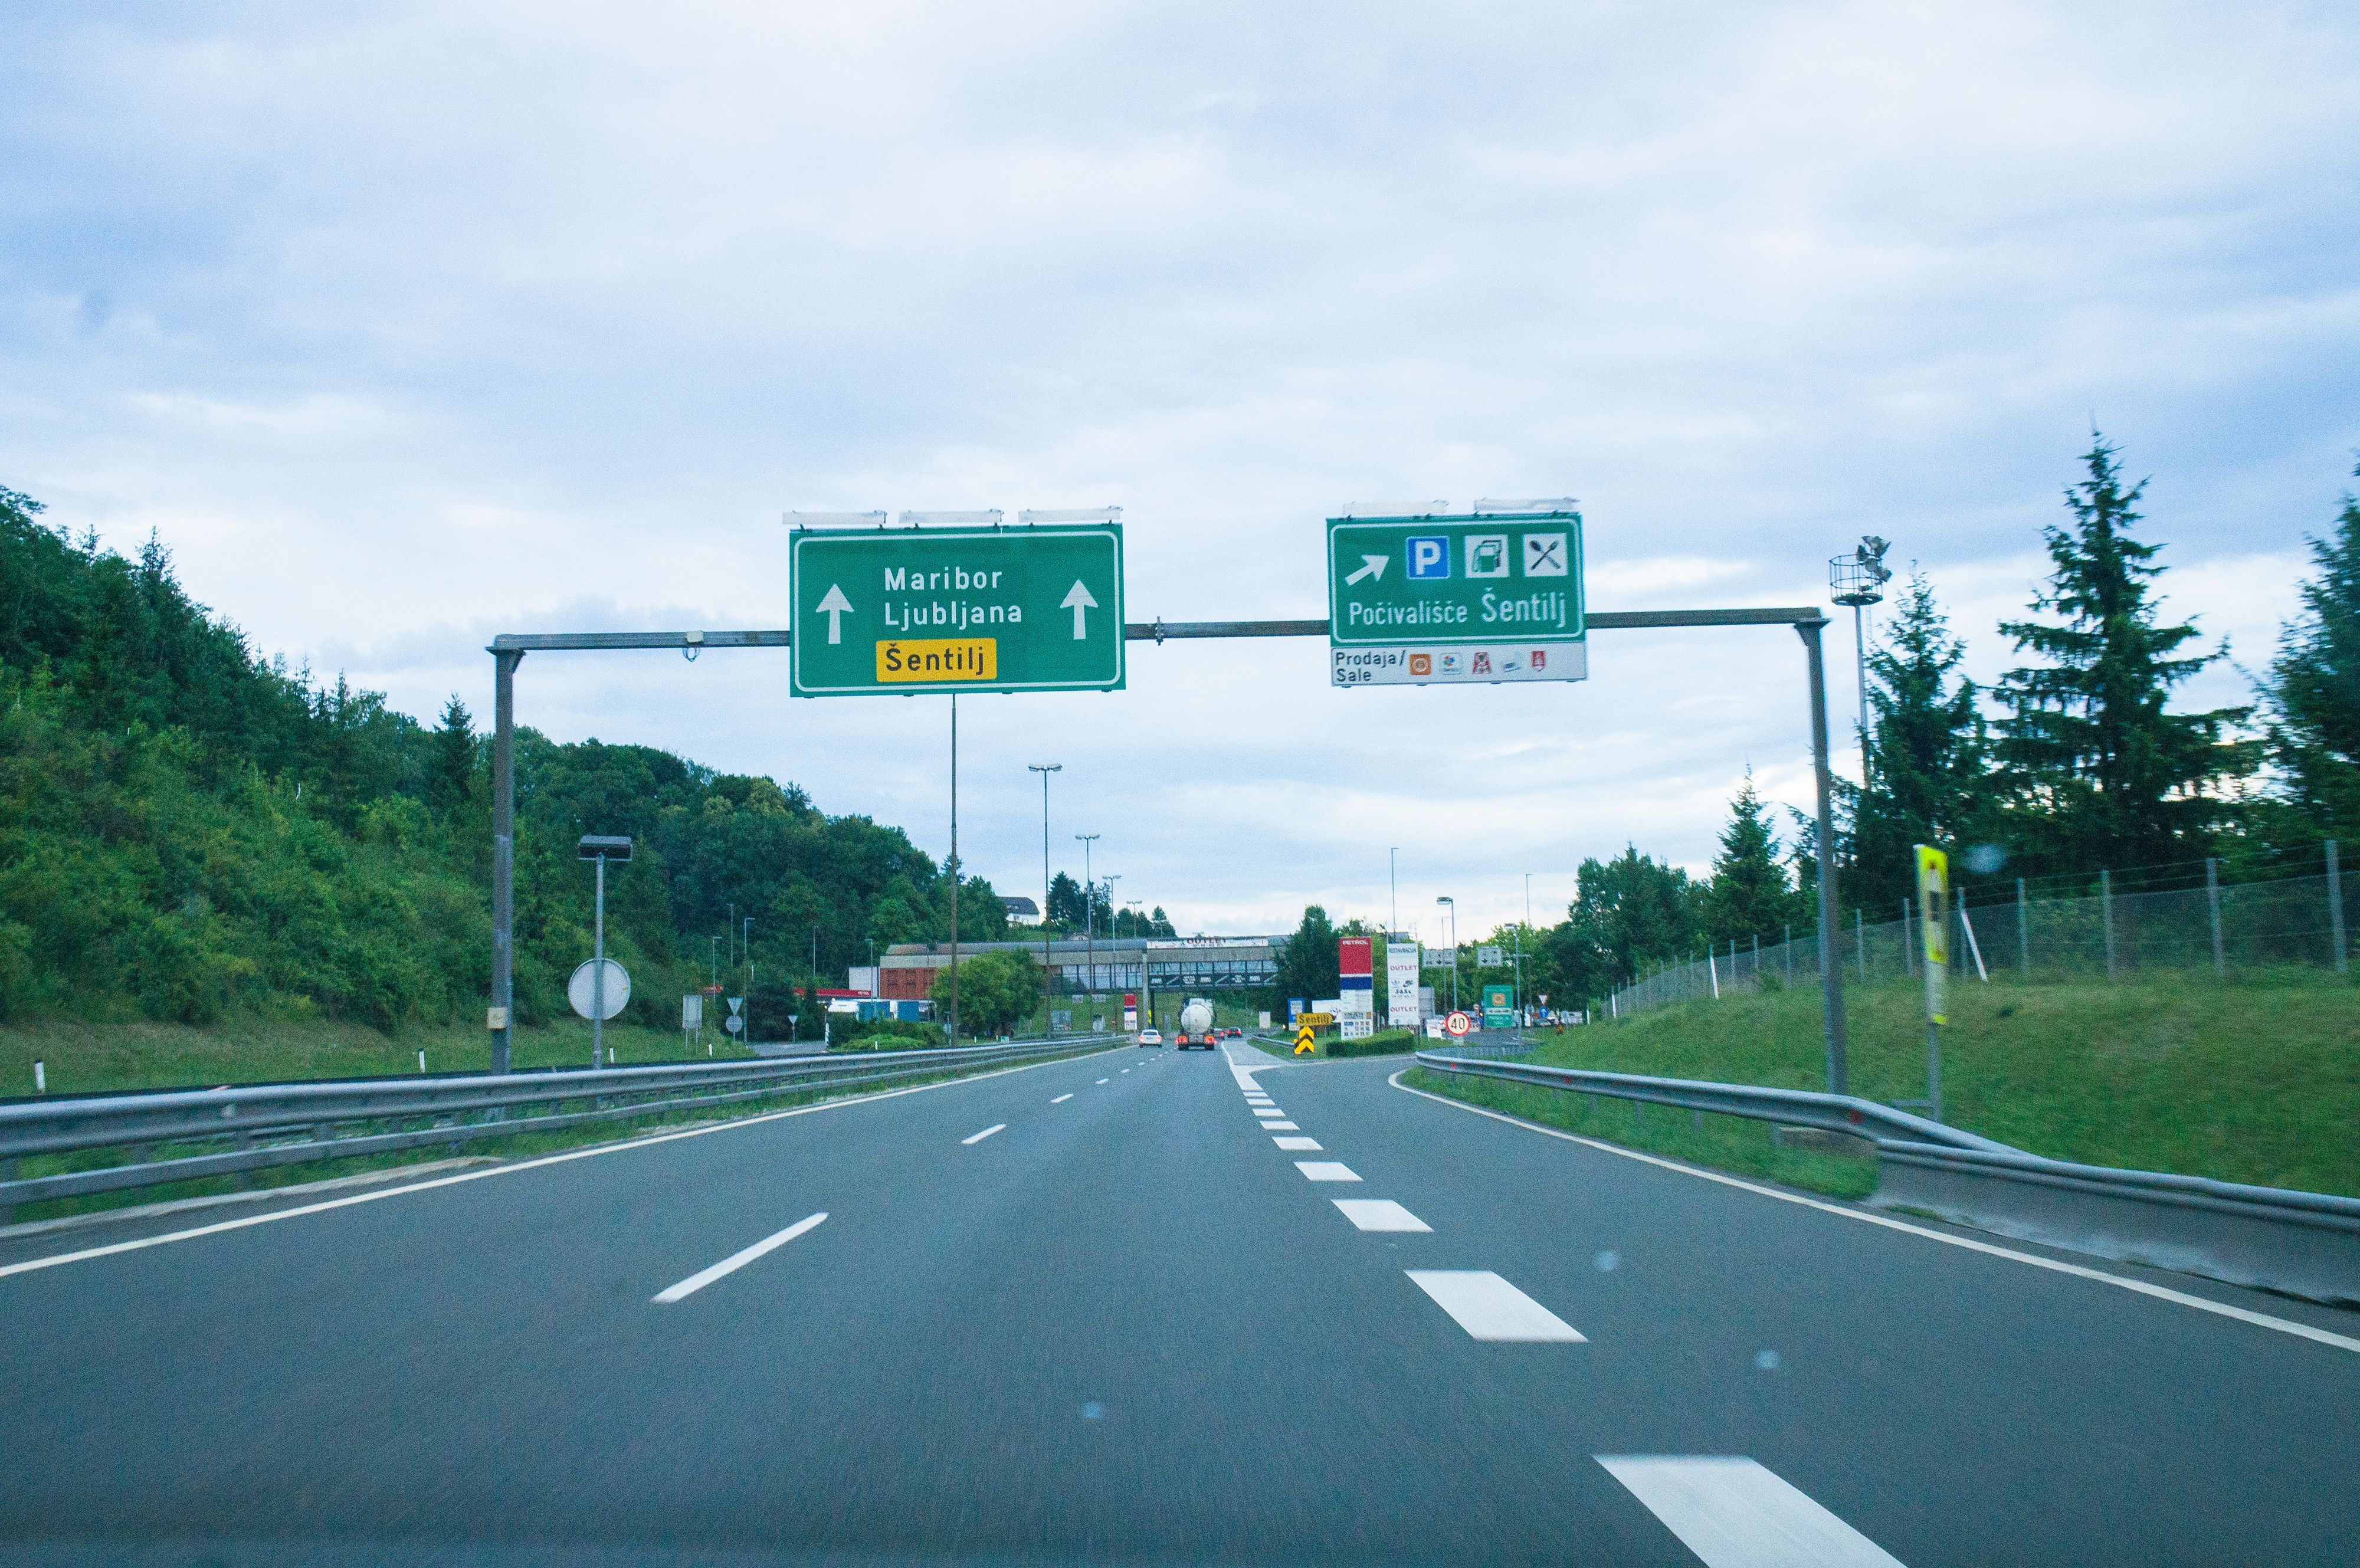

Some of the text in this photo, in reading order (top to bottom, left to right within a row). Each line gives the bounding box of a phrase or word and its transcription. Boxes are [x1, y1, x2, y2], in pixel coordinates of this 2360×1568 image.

[1415, 540, 1441, 576] P
[885, 566, 1002, 591] Maribor
[885, 601, 1022, 631] Ljubljana
[1349, 588, 1566, 628] Počivališče Šentilj
[886, 642, 984, 675] Šentilj
[1335, 649, 1406, 668] Prodaja/
[1336, 669, 1372, 682] Sale
[1450, 1018, 1466, 1030] 40
